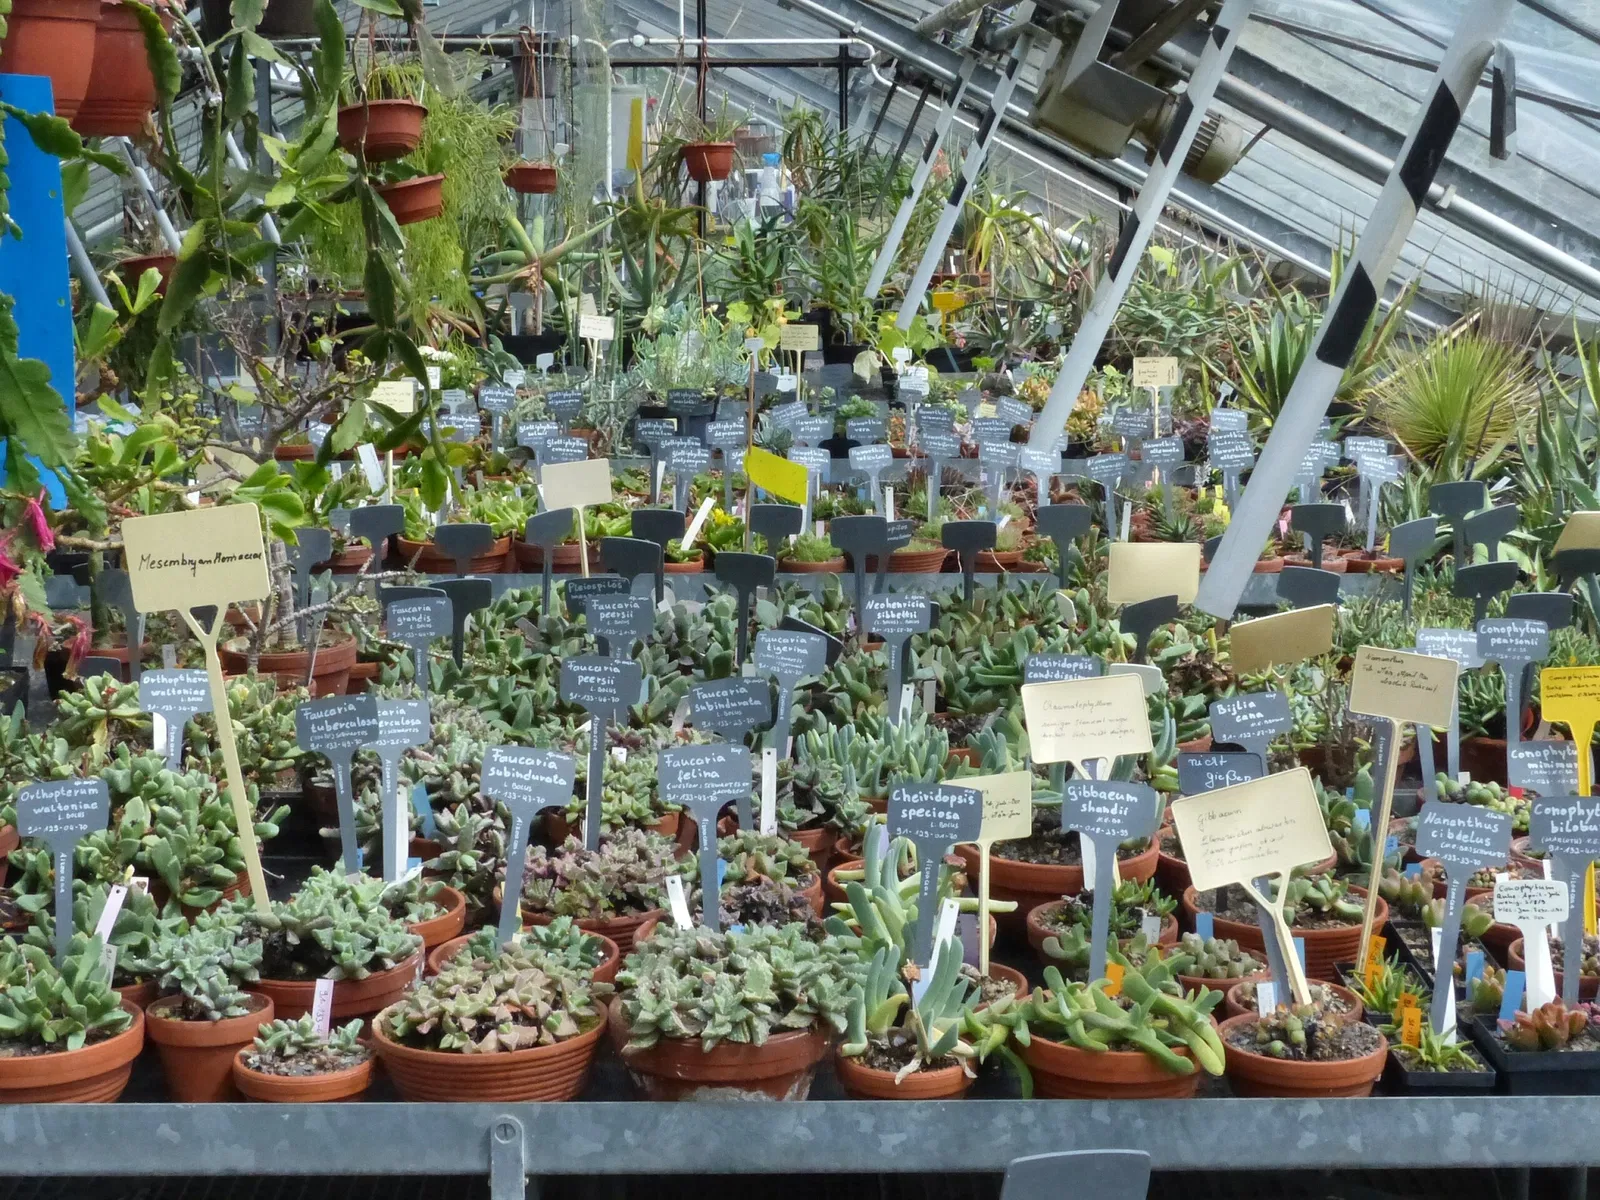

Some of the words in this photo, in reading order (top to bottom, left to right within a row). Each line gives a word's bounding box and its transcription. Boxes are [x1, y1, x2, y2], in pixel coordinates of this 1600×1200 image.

[392, 604, 432, 614] Faucaria
[592, 599, 640, 610] Faucaria
[866, 599, 926, 610] Neohenricia
[396, 615, 432, 626] grandis
[600, 612, 634, 622] peersii
[1480, 622, 1546, 638] Conophytum
[760, 634, 807, 644] Faucaria
[1419, 632, 1477, 645] Conophytum
[1490, 638, 1538, 647] pearsonii
[766, 644, 808, 654] tigerina
[568, 660, 620, 674] Faucaria
[1029, 656, 1092, 672] Cheiridopsis
[578, 676, 614, 686] peersii
[693, 685, 748, 700] Faucaria
[301, 702, 356, 720] Faucaria
[378, 706, 406, 717] caria
[694, 698, 762, 713] subindurata
[1216, 700, 1256, 716] Bijlia
[379, 716, 422, 728] erculosa
[1236, 712, 1264, 723] cana
[310, 717, 378, 733] tuberculosa
[488, 748, 558, 770] Faucaria
[664, 752, 726, 768] Faucaria
[1188, 755, 1227, 767] nicht
[488, 766, 567, 786] subindurata
[678, 768, 720, 783] felina
[21, 787, 100, 803] Orthopterum
[892, 788, 975, 808] Cheiridopsis
[1068, 784, 1138, 803] Gibbaeum
[33, 801, 98, 815] waltoniae
[900, 808, 960, 821] speciosa
[1080, 800, 1129, 816] shandii
[1424, 812, 1499, 833] Nananthus
[1550, 820, 1600, 834] bilobu
[1431, 828, 1491, 847] cibdelus
